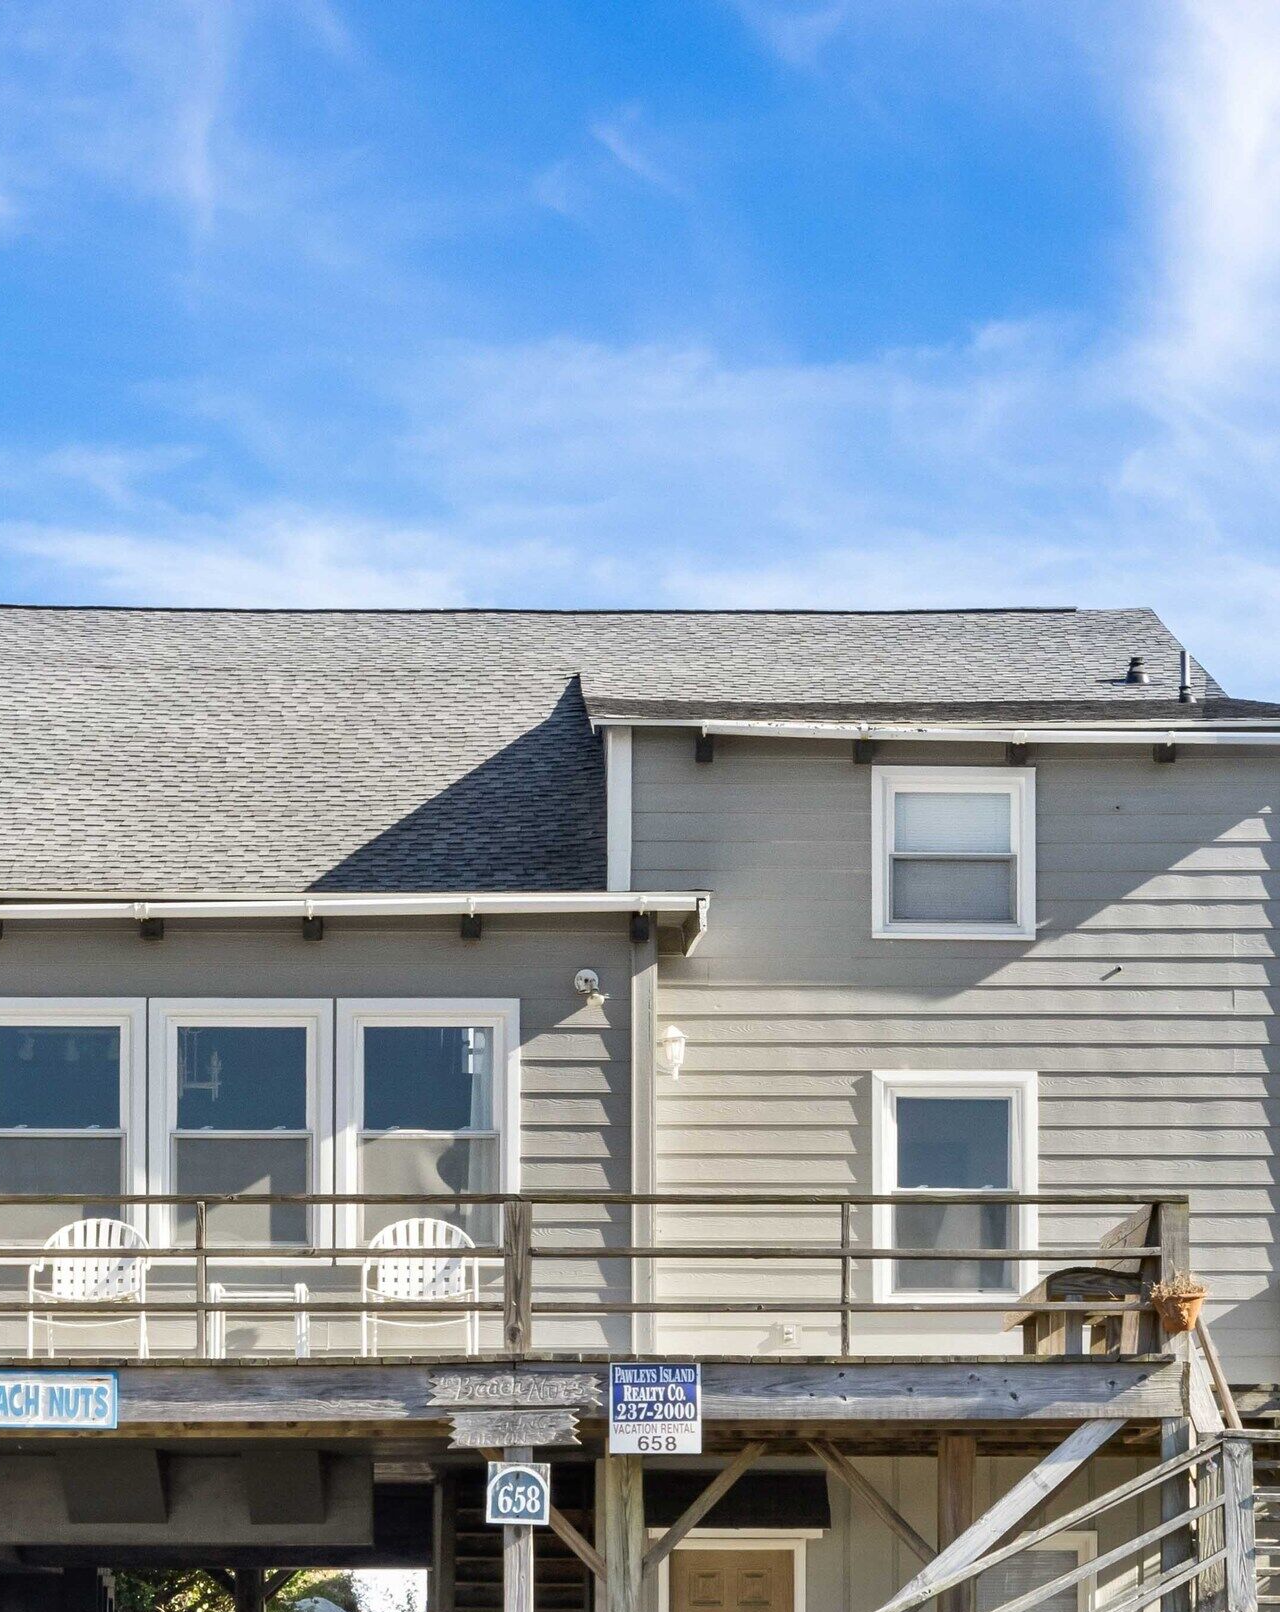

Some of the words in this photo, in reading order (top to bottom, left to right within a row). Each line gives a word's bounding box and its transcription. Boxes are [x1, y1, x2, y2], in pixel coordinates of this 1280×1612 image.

[614, 1366, 657, 1384] PAWLEYS
[659, 1366, 695, 1383] ISLAND
[623, 1384, 666, 1401] REALTY
[667, 1384, 686, 1401] CO.
[48, 1385, 109, 1419] NUTS
[617, 1402, 695, 1420] 237-2000
[613, 1423, 658, 1434] VACATION
[660, 1423, 695, 1434] RENTAL
[637, 1435, 677, 1451] 658
[497, 1482, 541, 1514] 658
